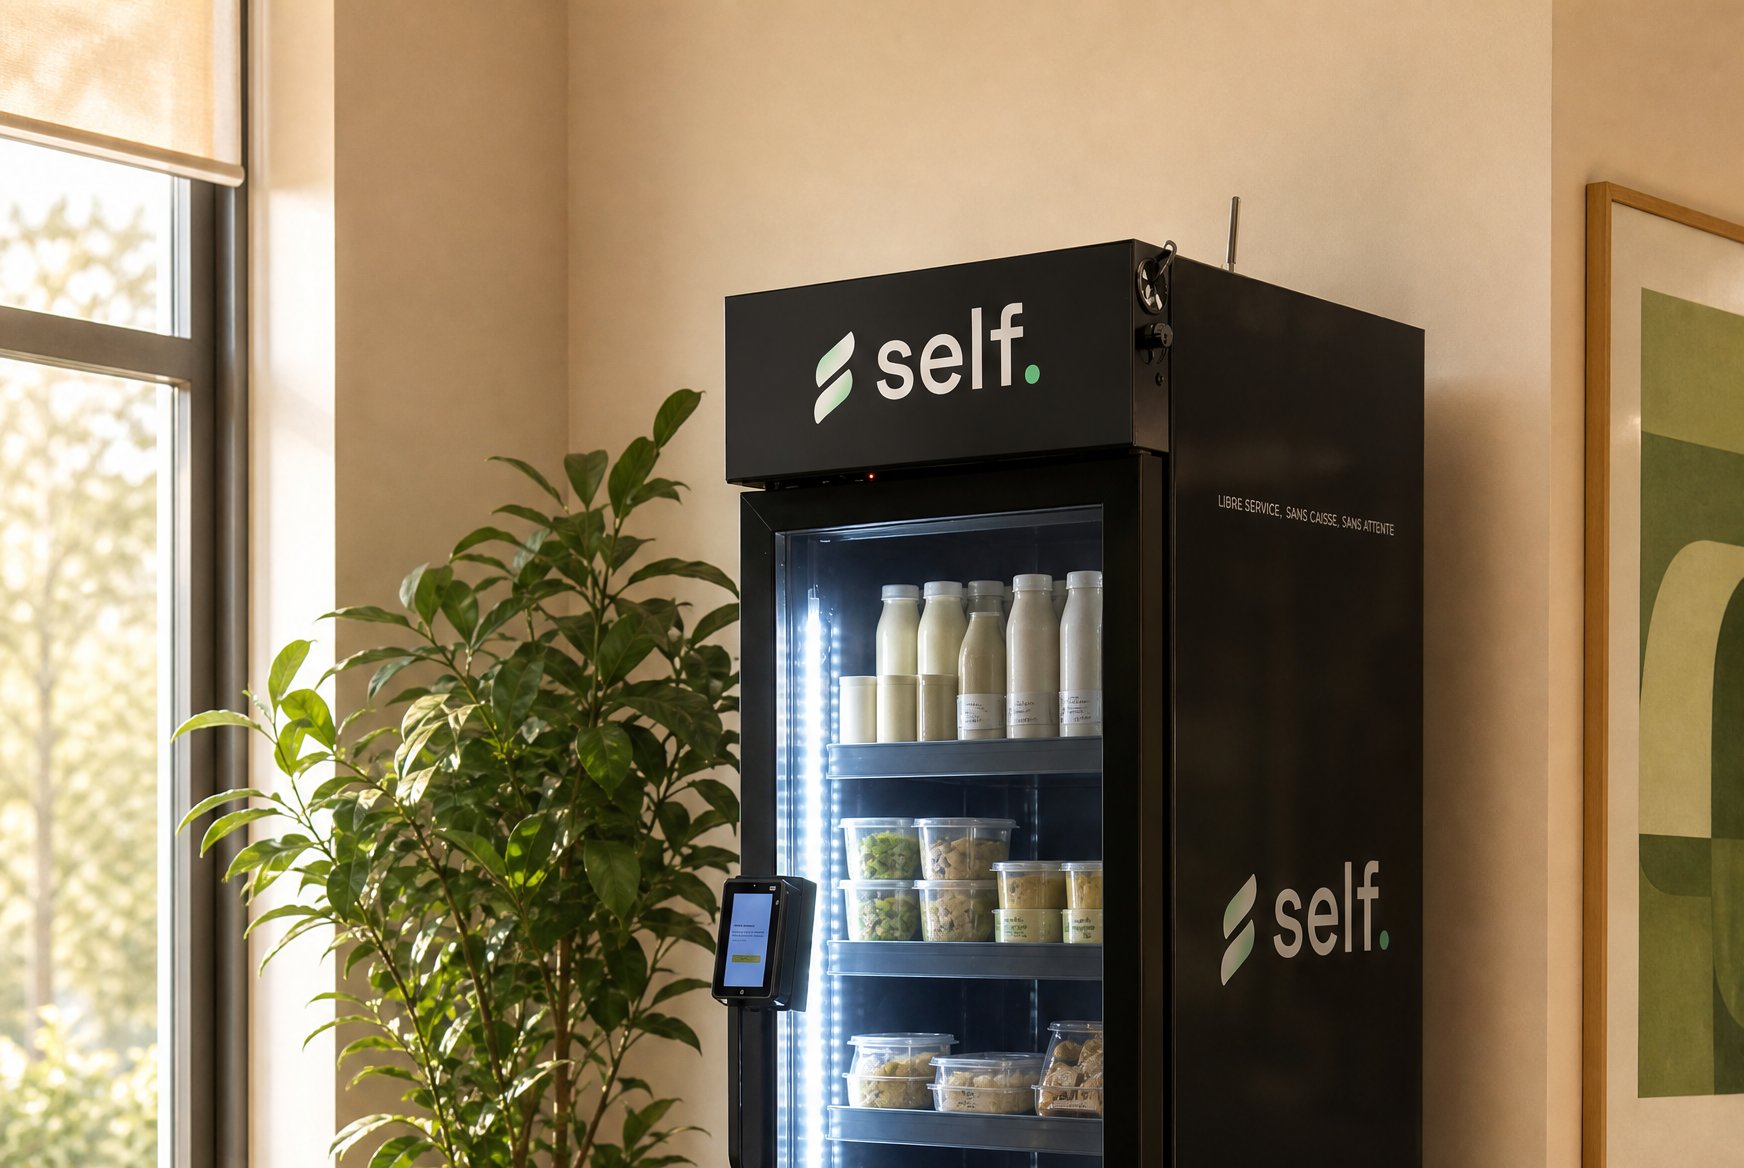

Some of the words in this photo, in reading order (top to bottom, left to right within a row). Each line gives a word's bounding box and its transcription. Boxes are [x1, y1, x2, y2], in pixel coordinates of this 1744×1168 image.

[876, 302, 1041, 401] self.
[1218, 494, 1243, 511] LIBRE
[1244, 499, 1283, 519] SERVICE,
[1286, 506, 1308, 522] SANS
[1309, 511, 1340, 528] CAISSE,
[1341, 516, 1362, 531] SANS
[1363, 520, 1395, 536] ATTENTE
[1273, 860, 1390, 959] self.
